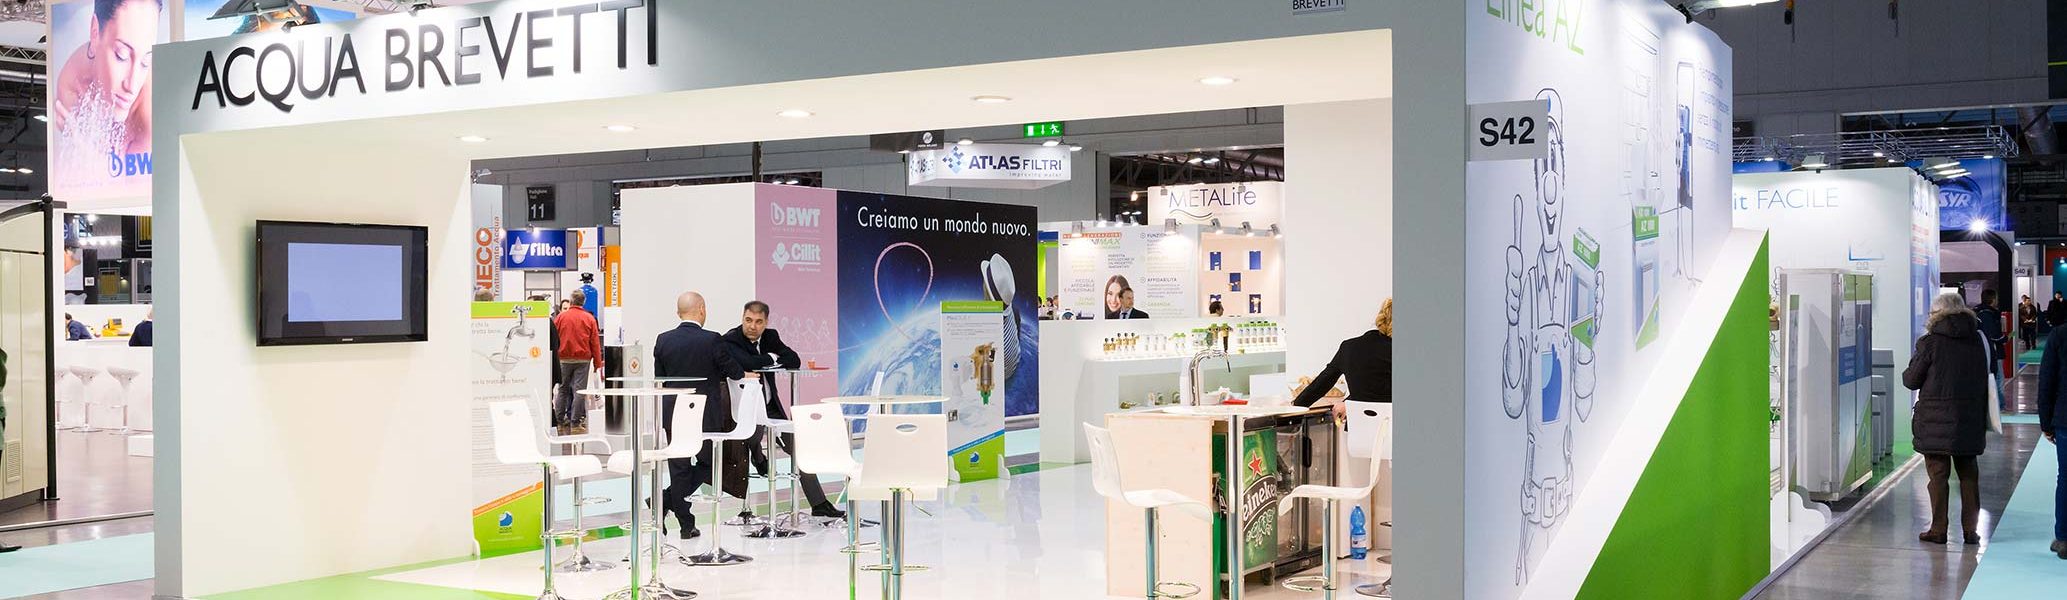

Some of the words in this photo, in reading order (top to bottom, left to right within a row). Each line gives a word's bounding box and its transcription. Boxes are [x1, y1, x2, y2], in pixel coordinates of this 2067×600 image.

[192, 33, 366, 112] ACQUA
[385, 0, 658, 92] BREVETTI
[1480, 116, 1536, 147] S42
[968, 155, 1020, 170] ATLAS
[1022, 159, 1062, 171] FILTRI
[1757, 187, 1839, 209] FACILE
[1939, 192, 1972, 208] SYR
[531, 203, 545, 219] 11
[786, 207, 821, 227] BWT
[857, 206, 918, 230] Creiamo
[923, 216, 939, 231] un
[944, 212, 988, 235] mondo
[992, 222, 1031, 237] nuovo.
[791, 242, 821, 261] Cillit
